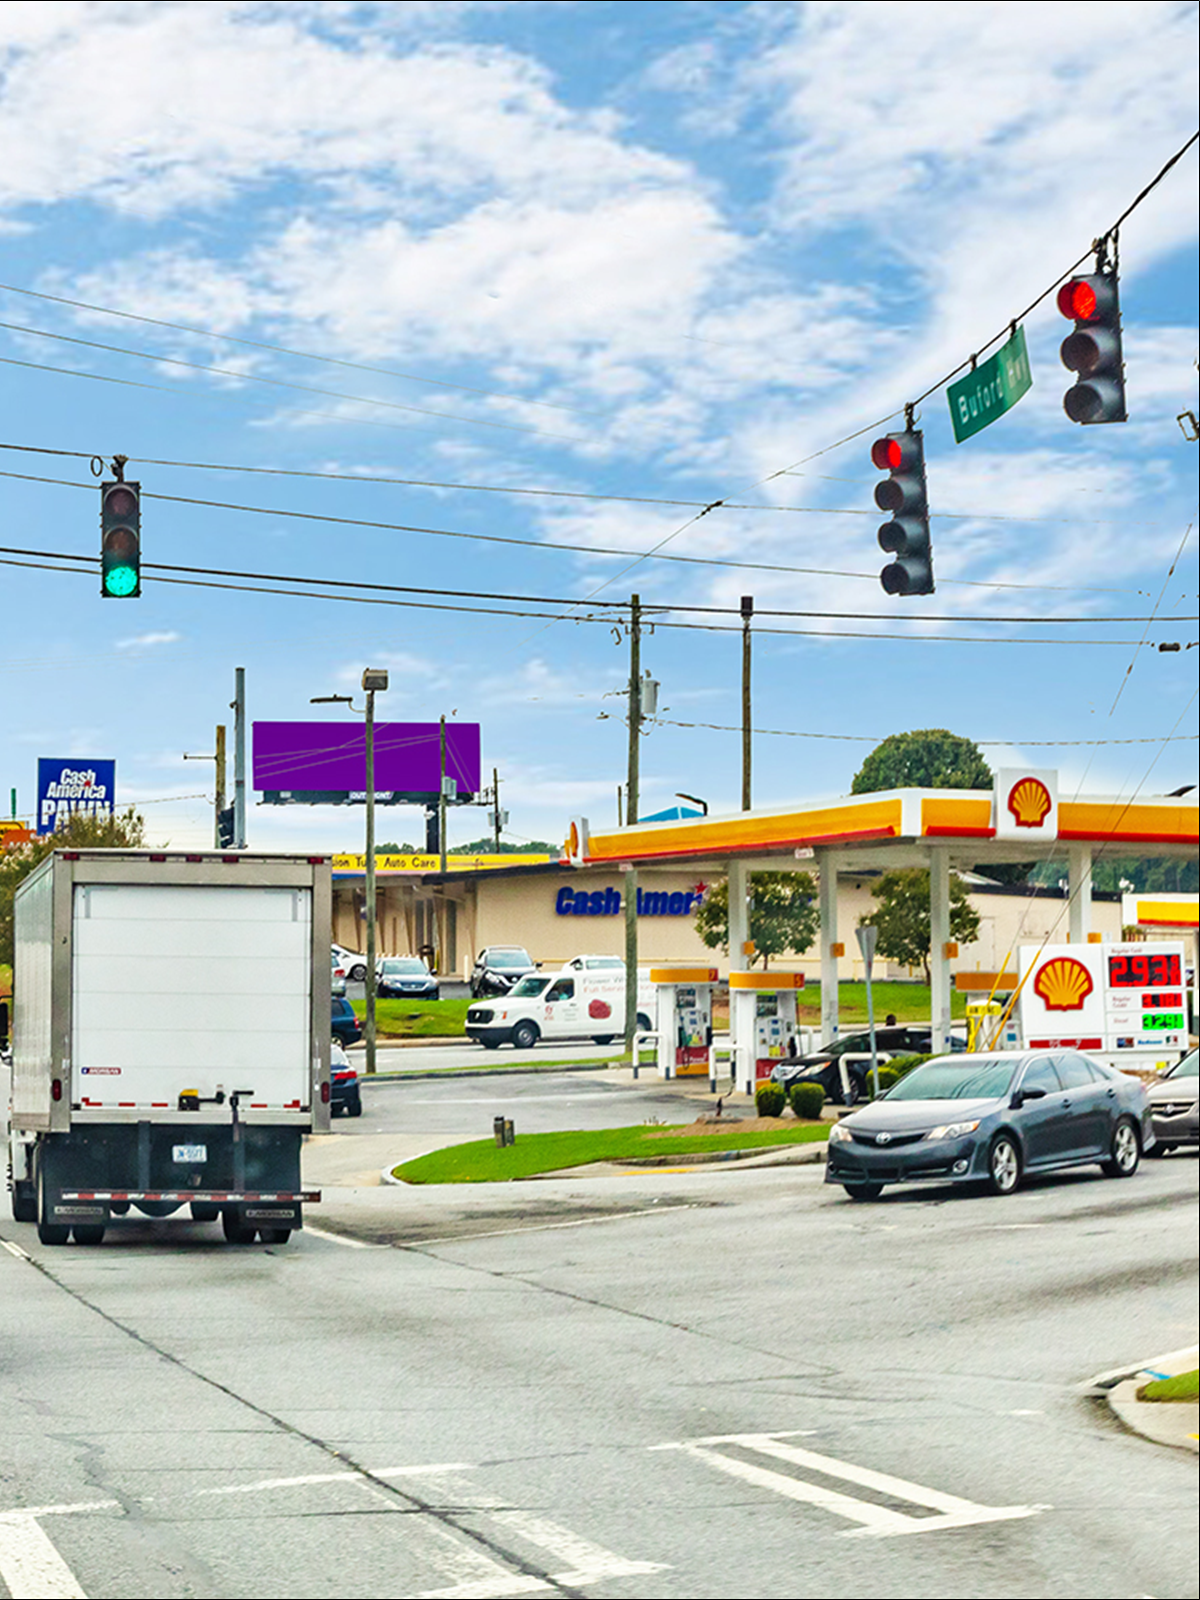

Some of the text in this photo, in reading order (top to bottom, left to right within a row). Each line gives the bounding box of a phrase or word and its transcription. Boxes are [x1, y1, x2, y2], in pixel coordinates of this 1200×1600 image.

[958, 371, 1004, 424] Buford
[60, 768, 96, 785] Cash
[46, 782, 106, 799] America
[355, 856, 377, 868] Tue
[384, 857, 406, 868] Auto
[411, 857, 436, 868] Care
[555, 886, 621, 915] Cash
[1110, 955, 1167, 987] 2.93
